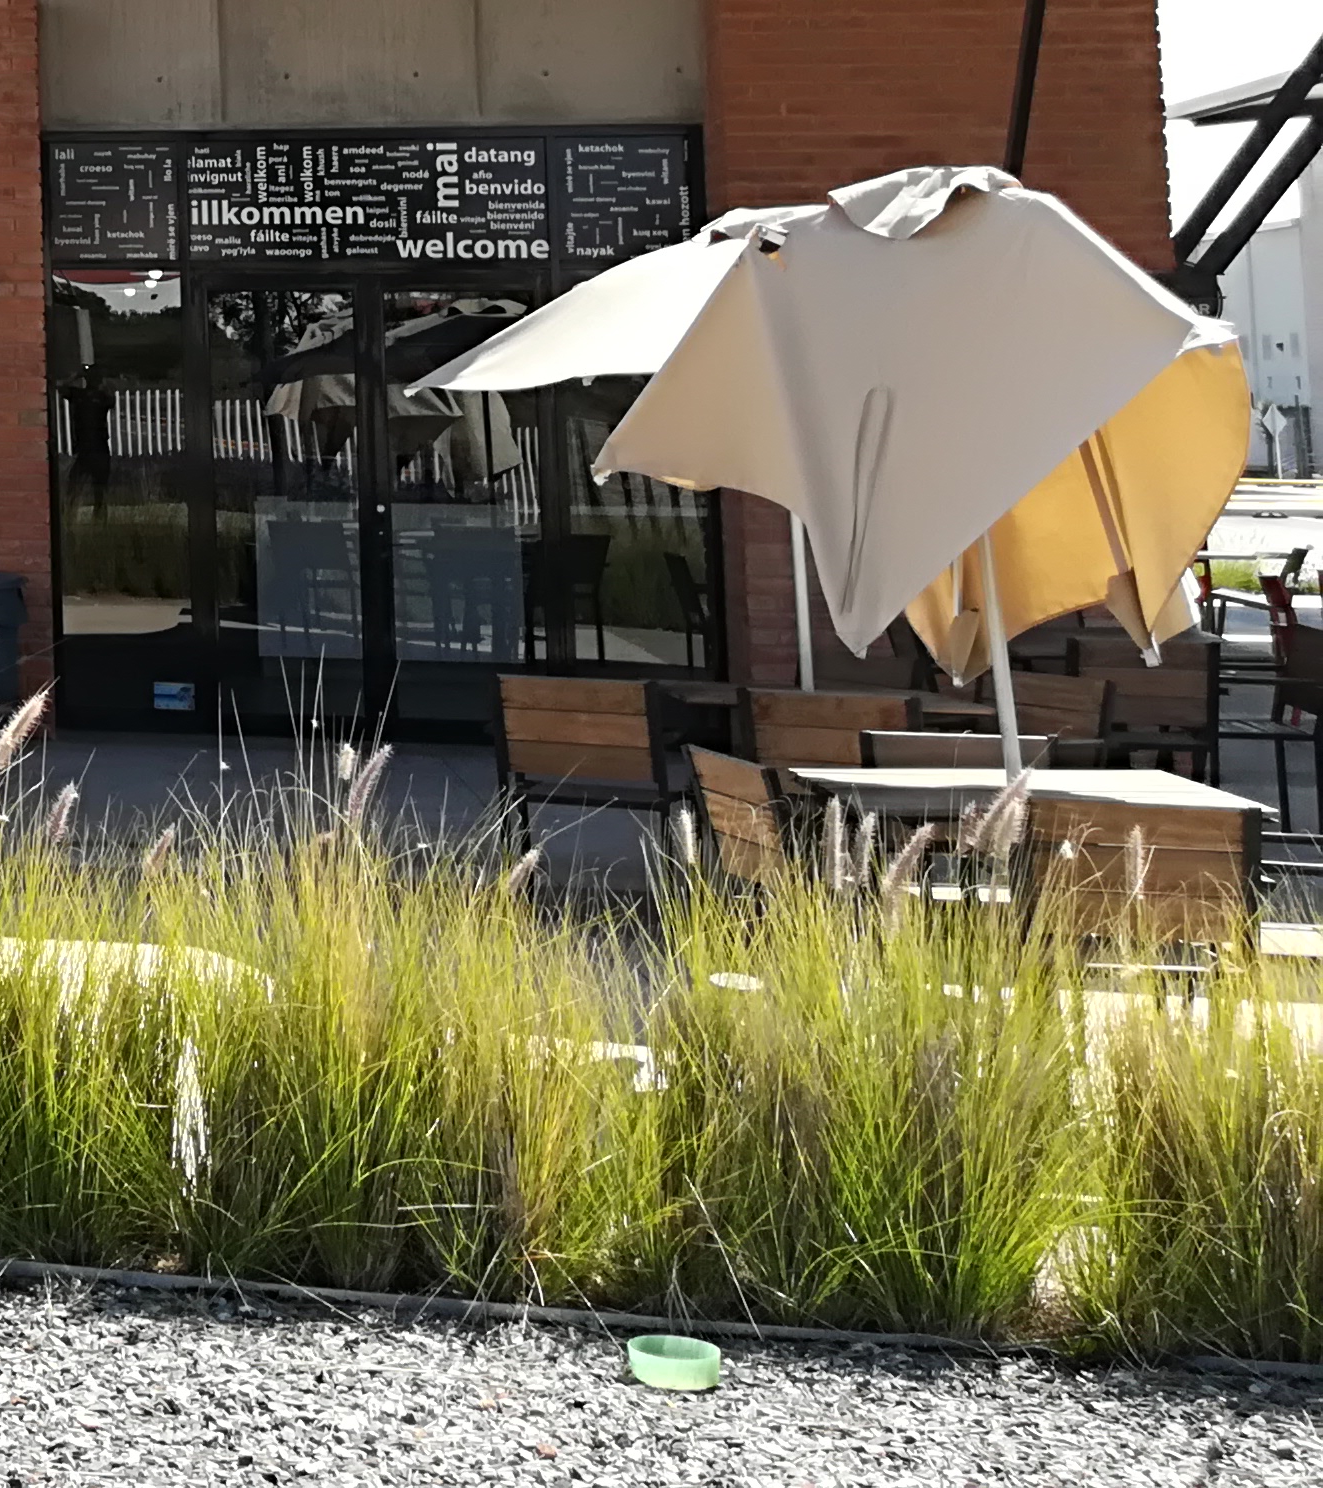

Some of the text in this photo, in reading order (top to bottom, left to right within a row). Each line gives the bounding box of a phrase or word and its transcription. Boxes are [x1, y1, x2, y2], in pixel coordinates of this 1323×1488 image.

[463, 146, 536, 167] datang
[79, 165, 113, 173] croeso
[254, 146, 268, 203] welkom
[300, 145, 314, 203] wolkom
[187, 170, 243, 185] nvignut
[380, 182, 424, 192] degemer
[464, 179, 546, 195] benvido
[488, 200, 546, 210] bienvenida
[486, 211, 545, 220] bienvenido
[395, 231, 550, 260] welcome
[576, 244, 615, 258] nayak
